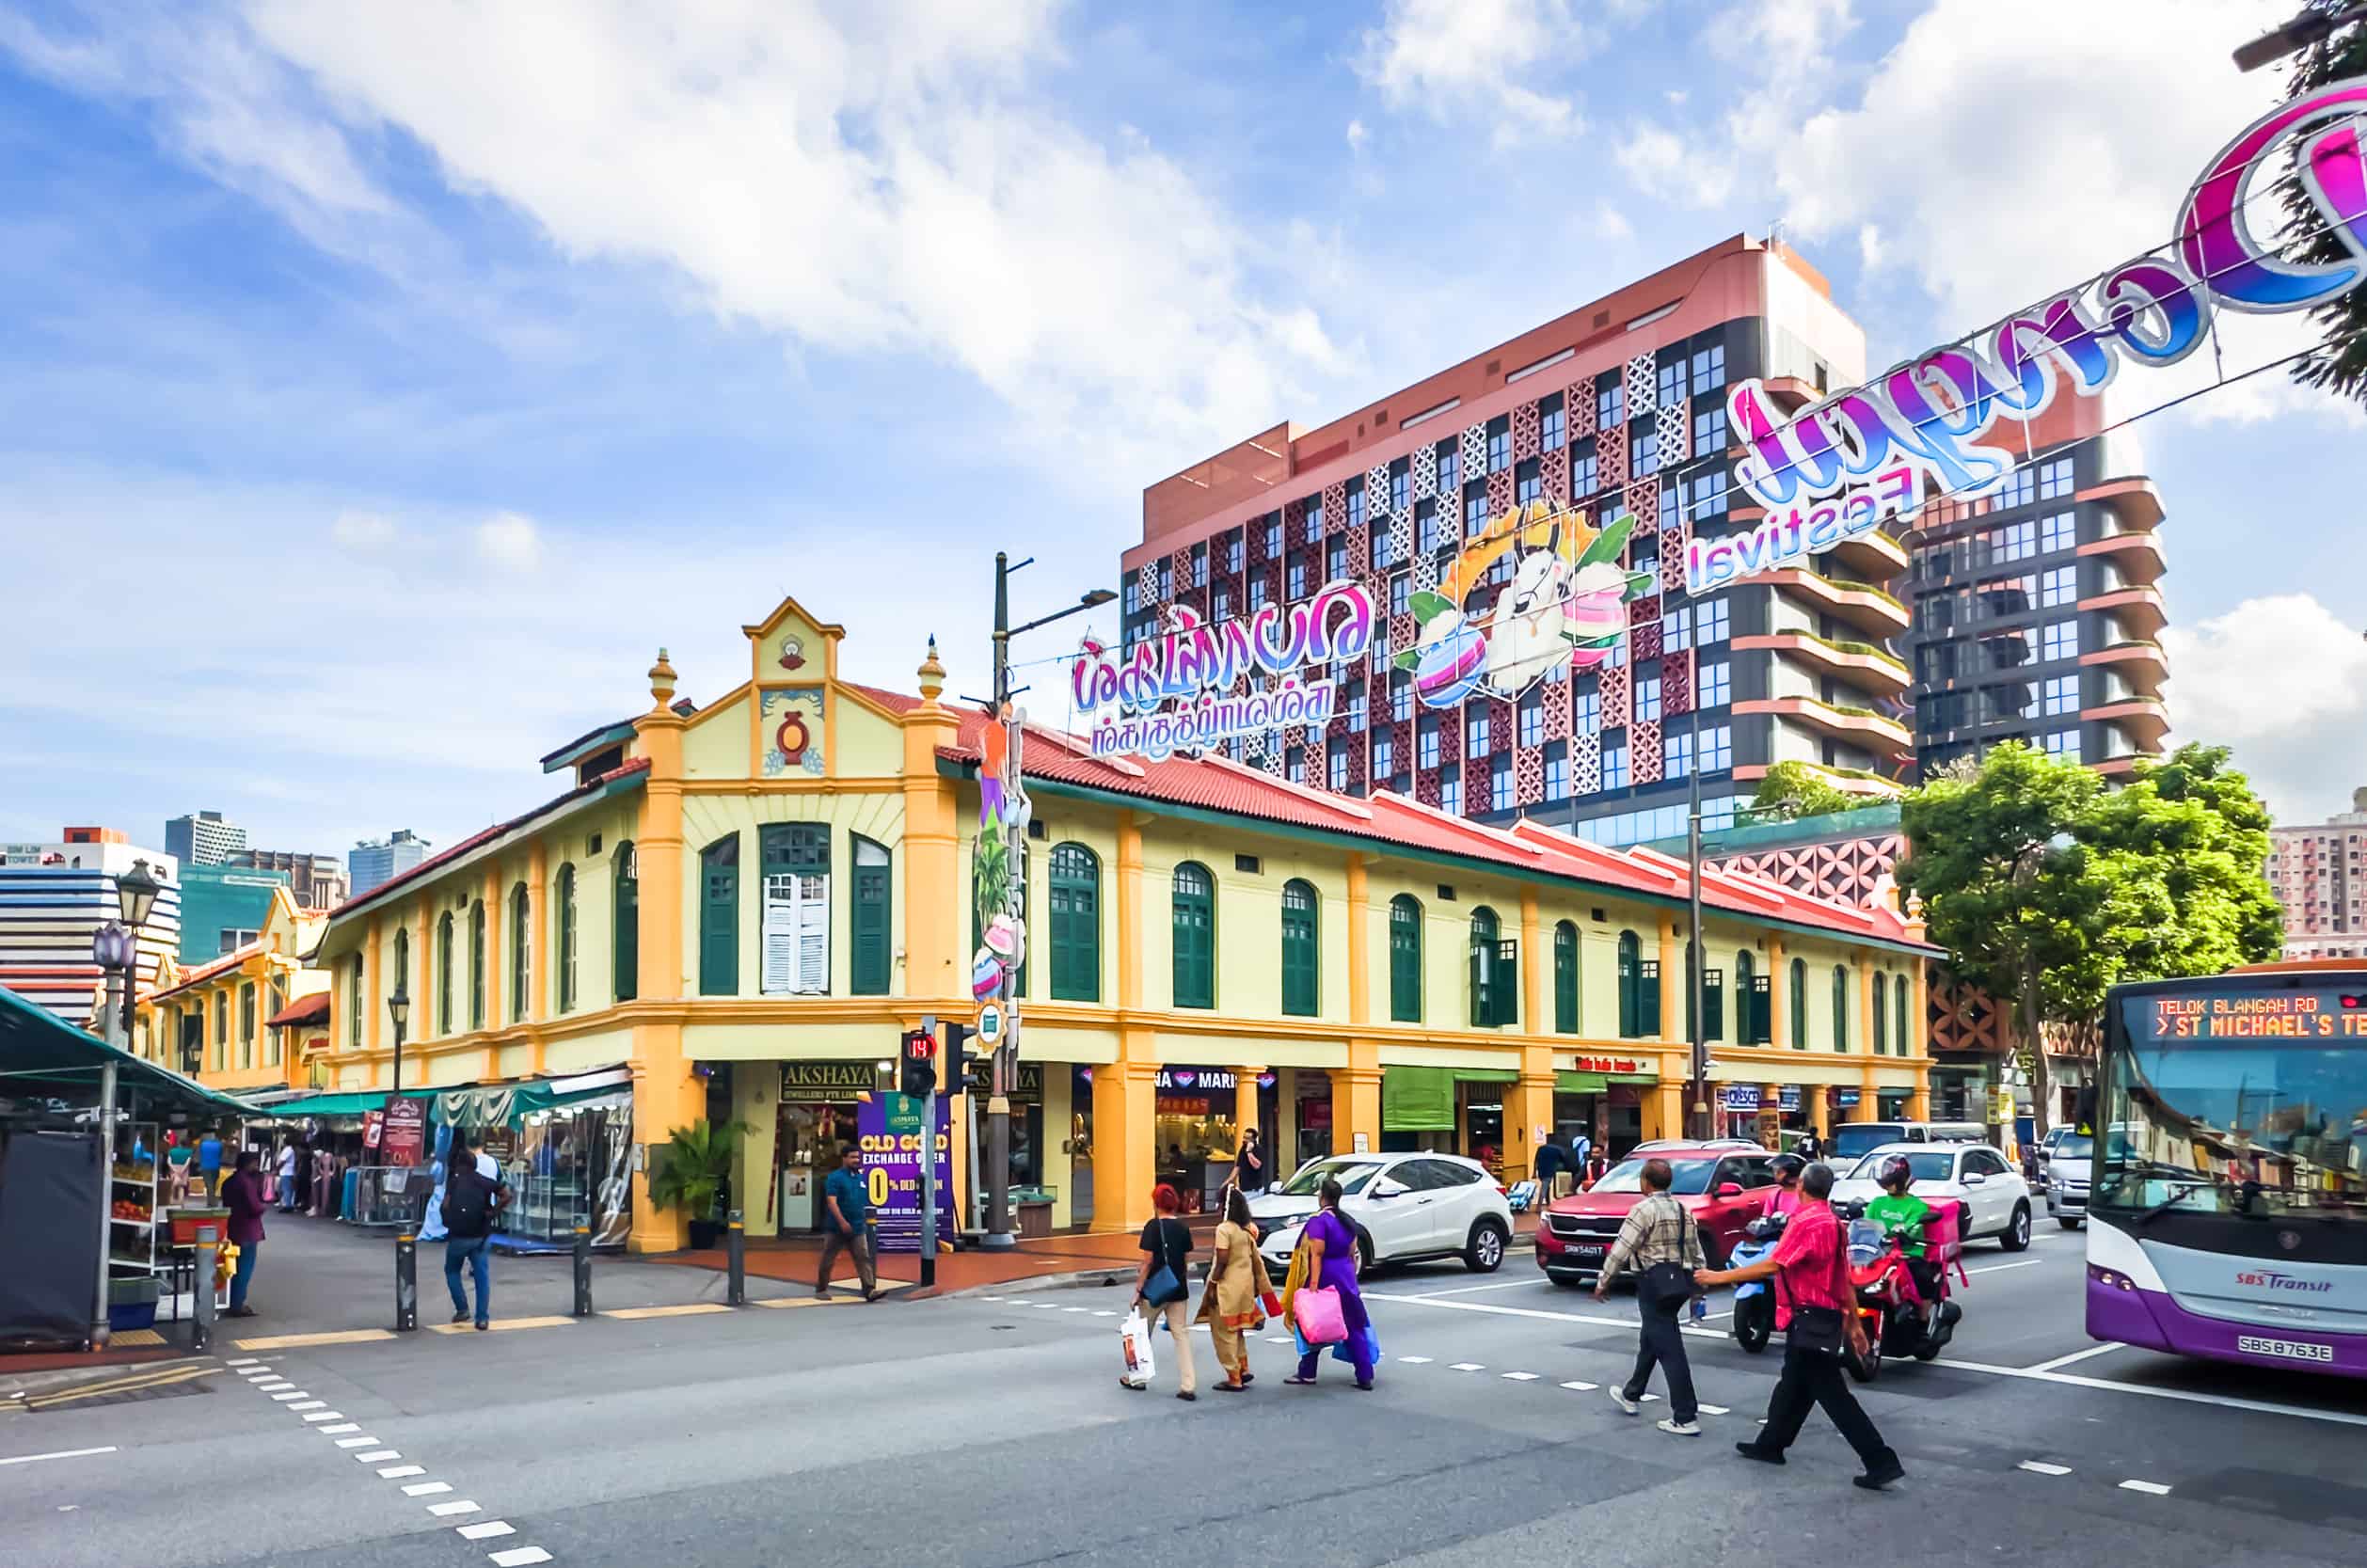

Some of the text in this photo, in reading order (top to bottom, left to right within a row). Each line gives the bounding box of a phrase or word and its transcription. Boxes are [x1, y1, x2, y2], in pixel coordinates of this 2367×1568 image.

[2156, 997, 2318, 1015] TELOK BLANGAH RD
[2176, 1016, 2202, 1037] ST
[2210, 1014, 2333, 1037] MICHAEL'S
[913, 1039, 927, 1057] 14
[785, 1066, 872, 1085] AKSHAYA
[860, 1134, 948, 1152] OLD GOD
[863, 1152, 945, 1164] EXCHANGE OER
[2235, 1273, 2333, 1292] SBS Transit
[2239, 1337, 2331, 1360] SBS8763E
